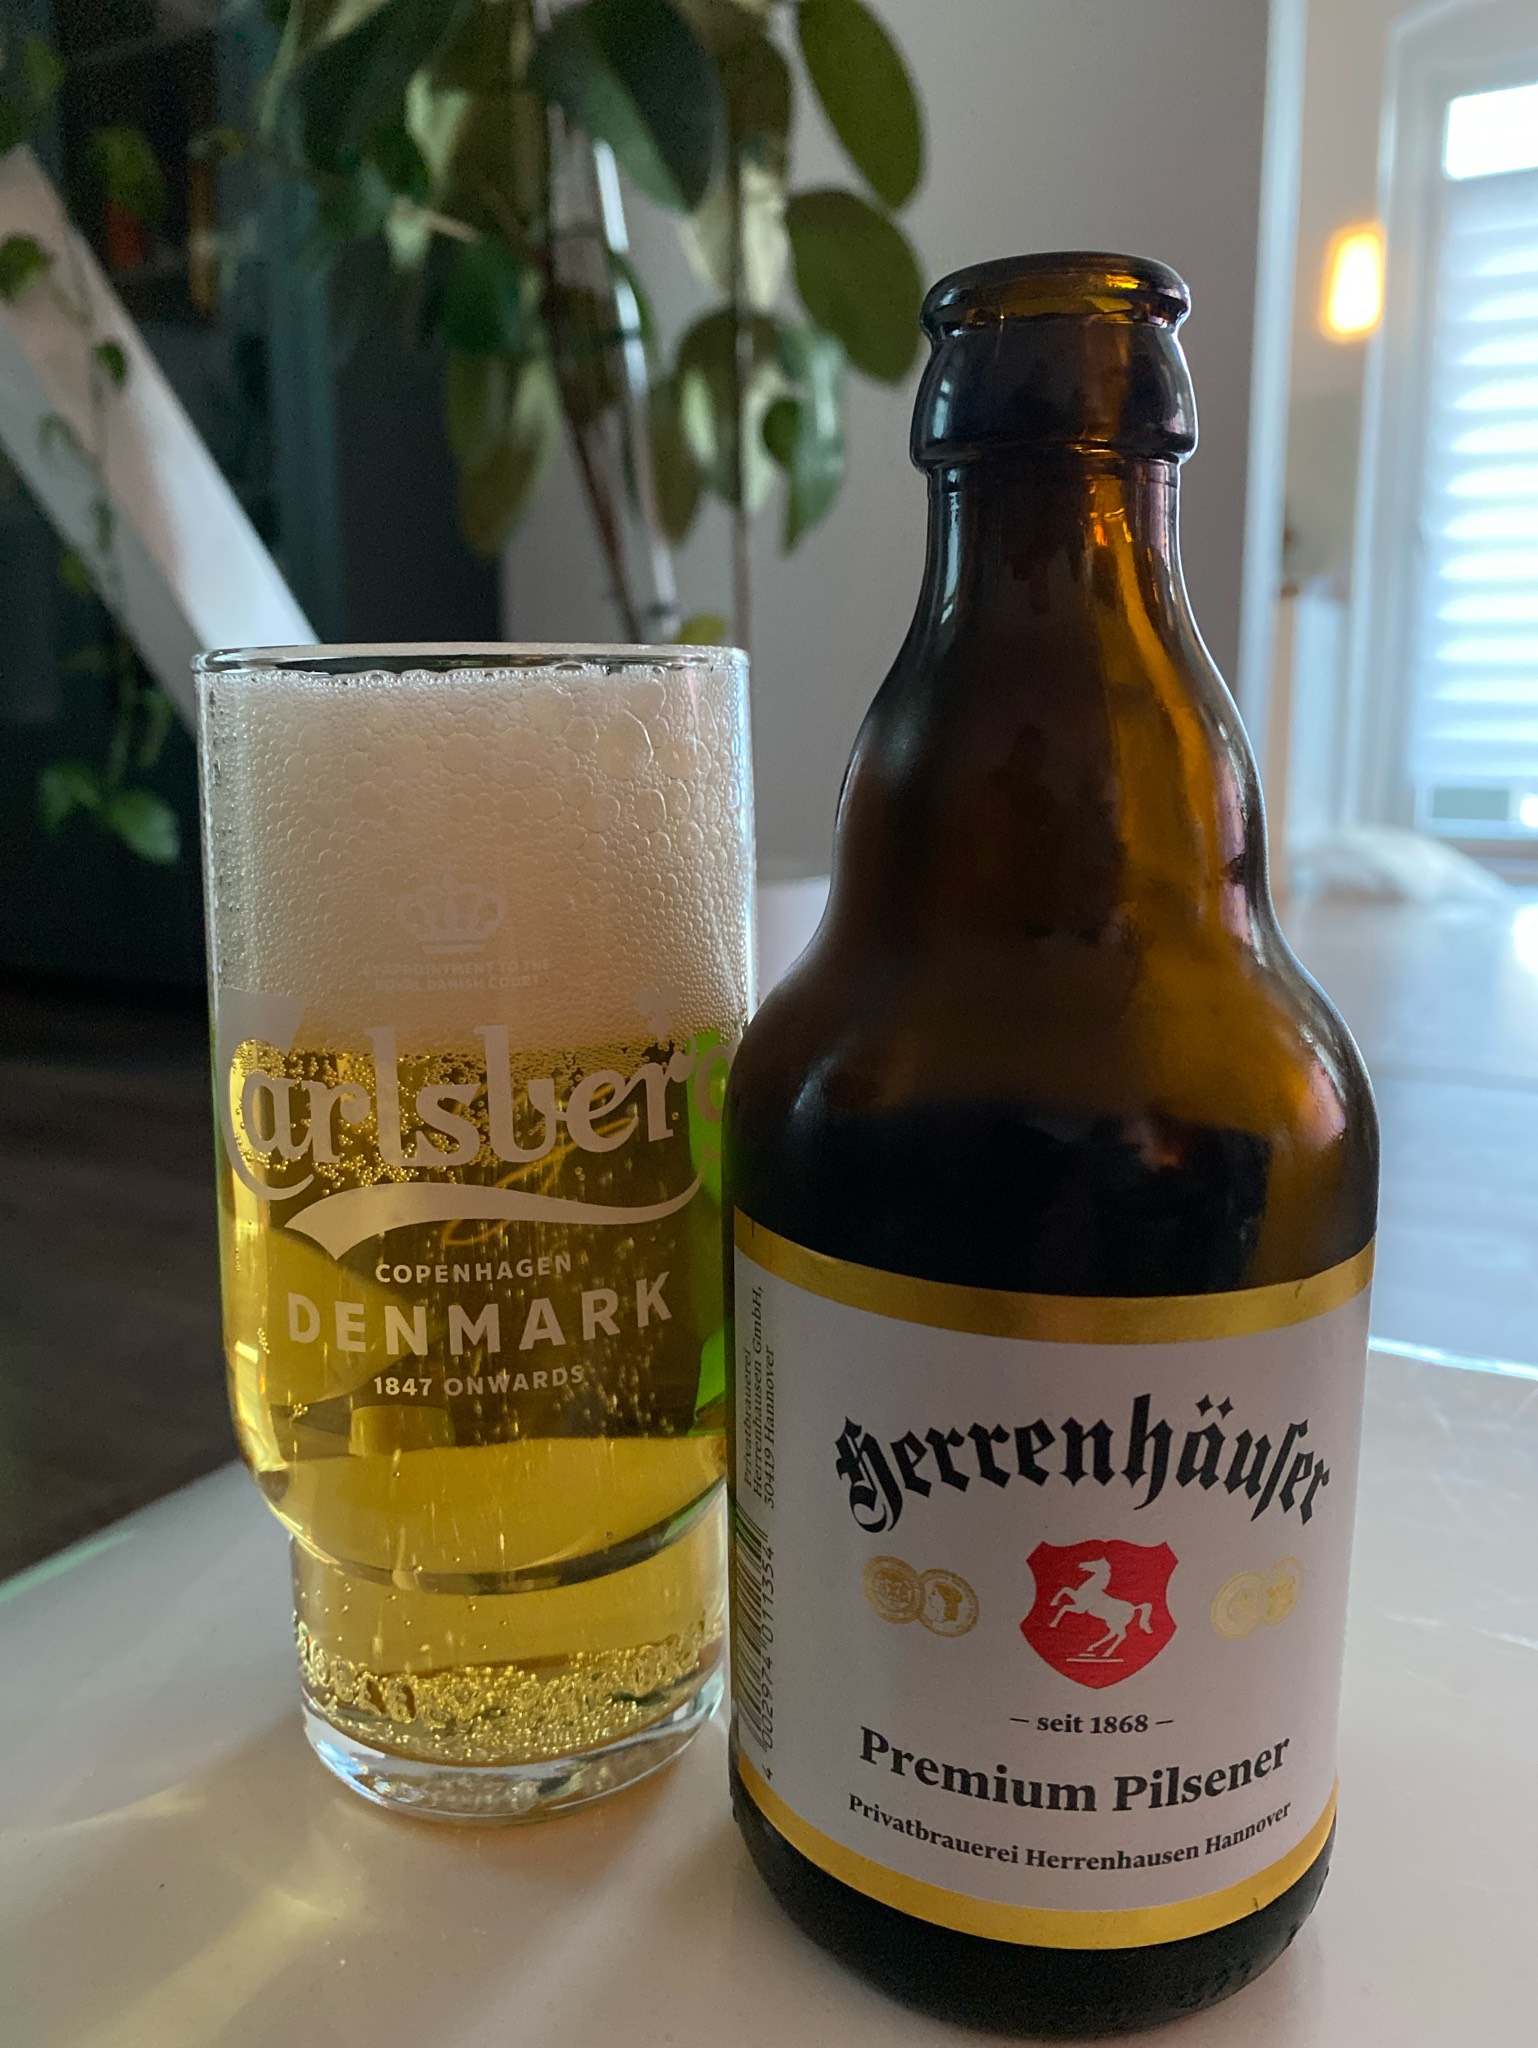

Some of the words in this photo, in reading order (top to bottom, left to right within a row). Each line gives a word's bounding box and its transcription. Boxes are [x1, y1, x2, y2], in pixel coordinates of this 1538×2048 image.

[374, 1253, 573, 1284] COPENHAGEN
[287, 1271, 672, 1356] DENMARK
[751, 1286, 763, 1354] GmbH,
[373, 1376, 433, 1396] 1847
[443, 1364, 585, 1397] ONWARDS
[743, 1346, 752, 1488] Privatbrauerei
[763, 1345, 775, 1446] Hannover
[752, 1360, 762, 1498] Herrenhausen
[1036, 1713, 1083, 1734] seit
[1090, 1714, 1149, 1734] 1868
[859, 1725, 1097, 1812] Premium
[1111, 1737, 1290, 1812] Pilsener
[848, 1793, 1018, 1864] Privatbrauerei
[1025, 1842, 1200, 1871] Herrenhausen
[1204, 1800, 1292, 1856] Hannover
